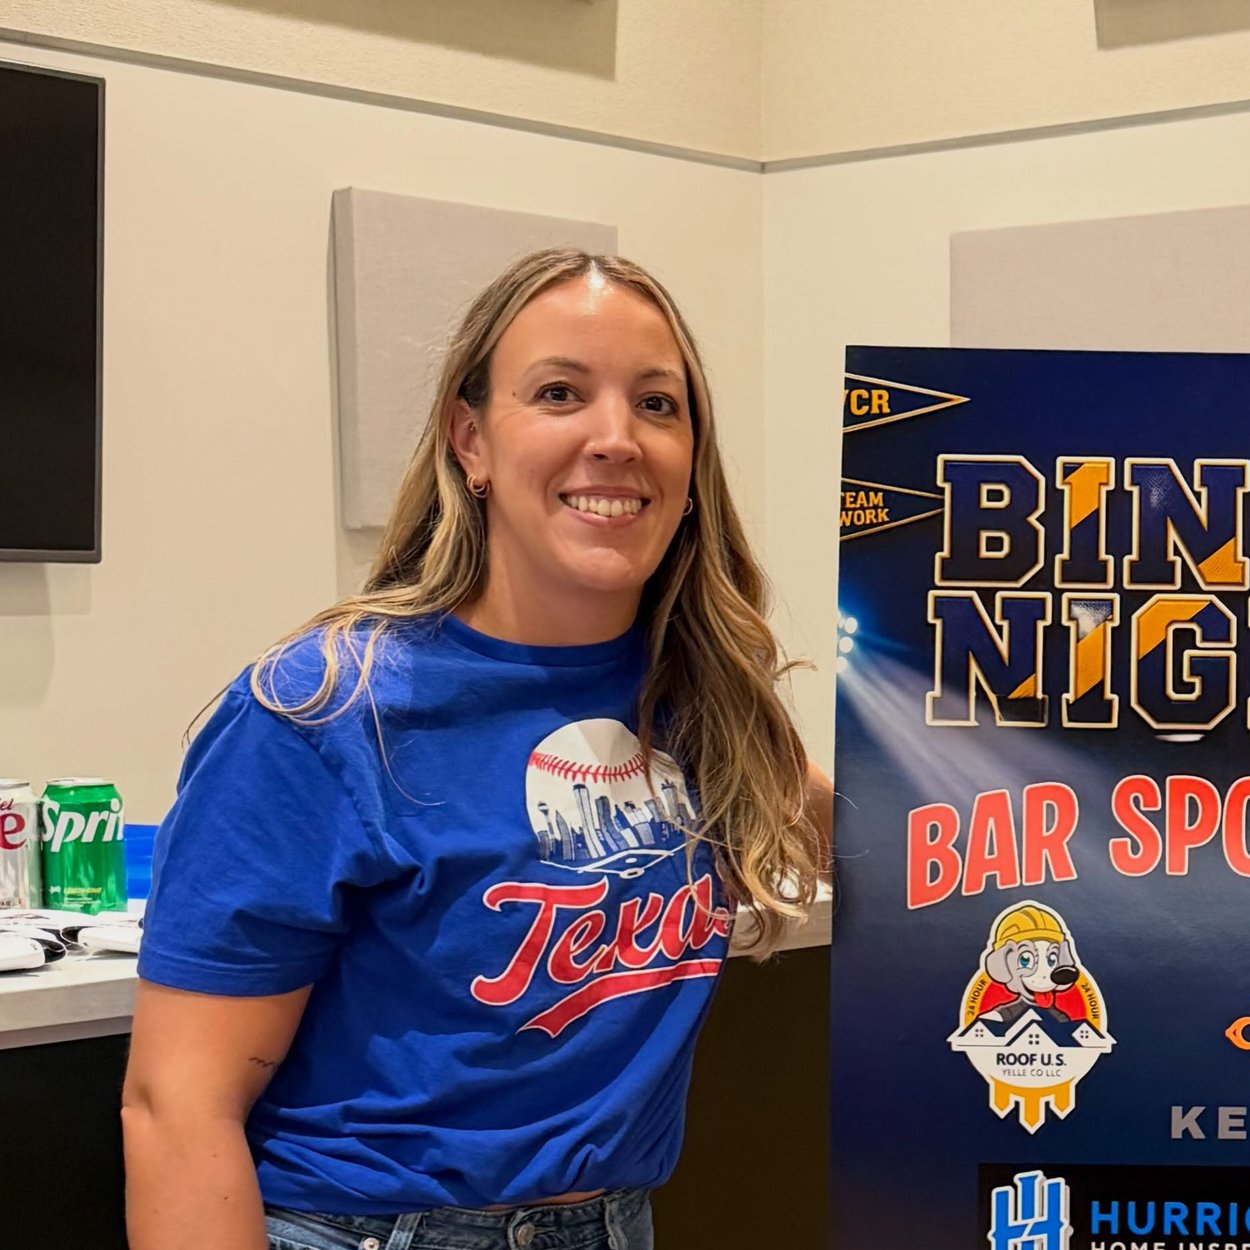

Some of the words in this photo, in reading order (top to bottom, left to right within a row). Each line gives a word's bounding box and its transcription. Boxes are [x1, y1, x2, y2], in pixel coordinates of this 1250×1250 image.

[844, 388, 890, 416] CR
[841, 491, 884, 508] EAM
[907, 781, 1079, 910] BAR
[970, 978, 988, 1004] HOUR
[966, 1003, 976, 1016] 24
[1086, 993, 1100, 1020] HOUR
[996, 1053, 1037, 1066] ROOF
[1041, 1053, 1067, 1067] U.S.
[1001, 1068, 1027, 1077] YELLE
[1030, 1068, 1044, 1077] CO
[1045, 1068, 1061, 1077] LLC
